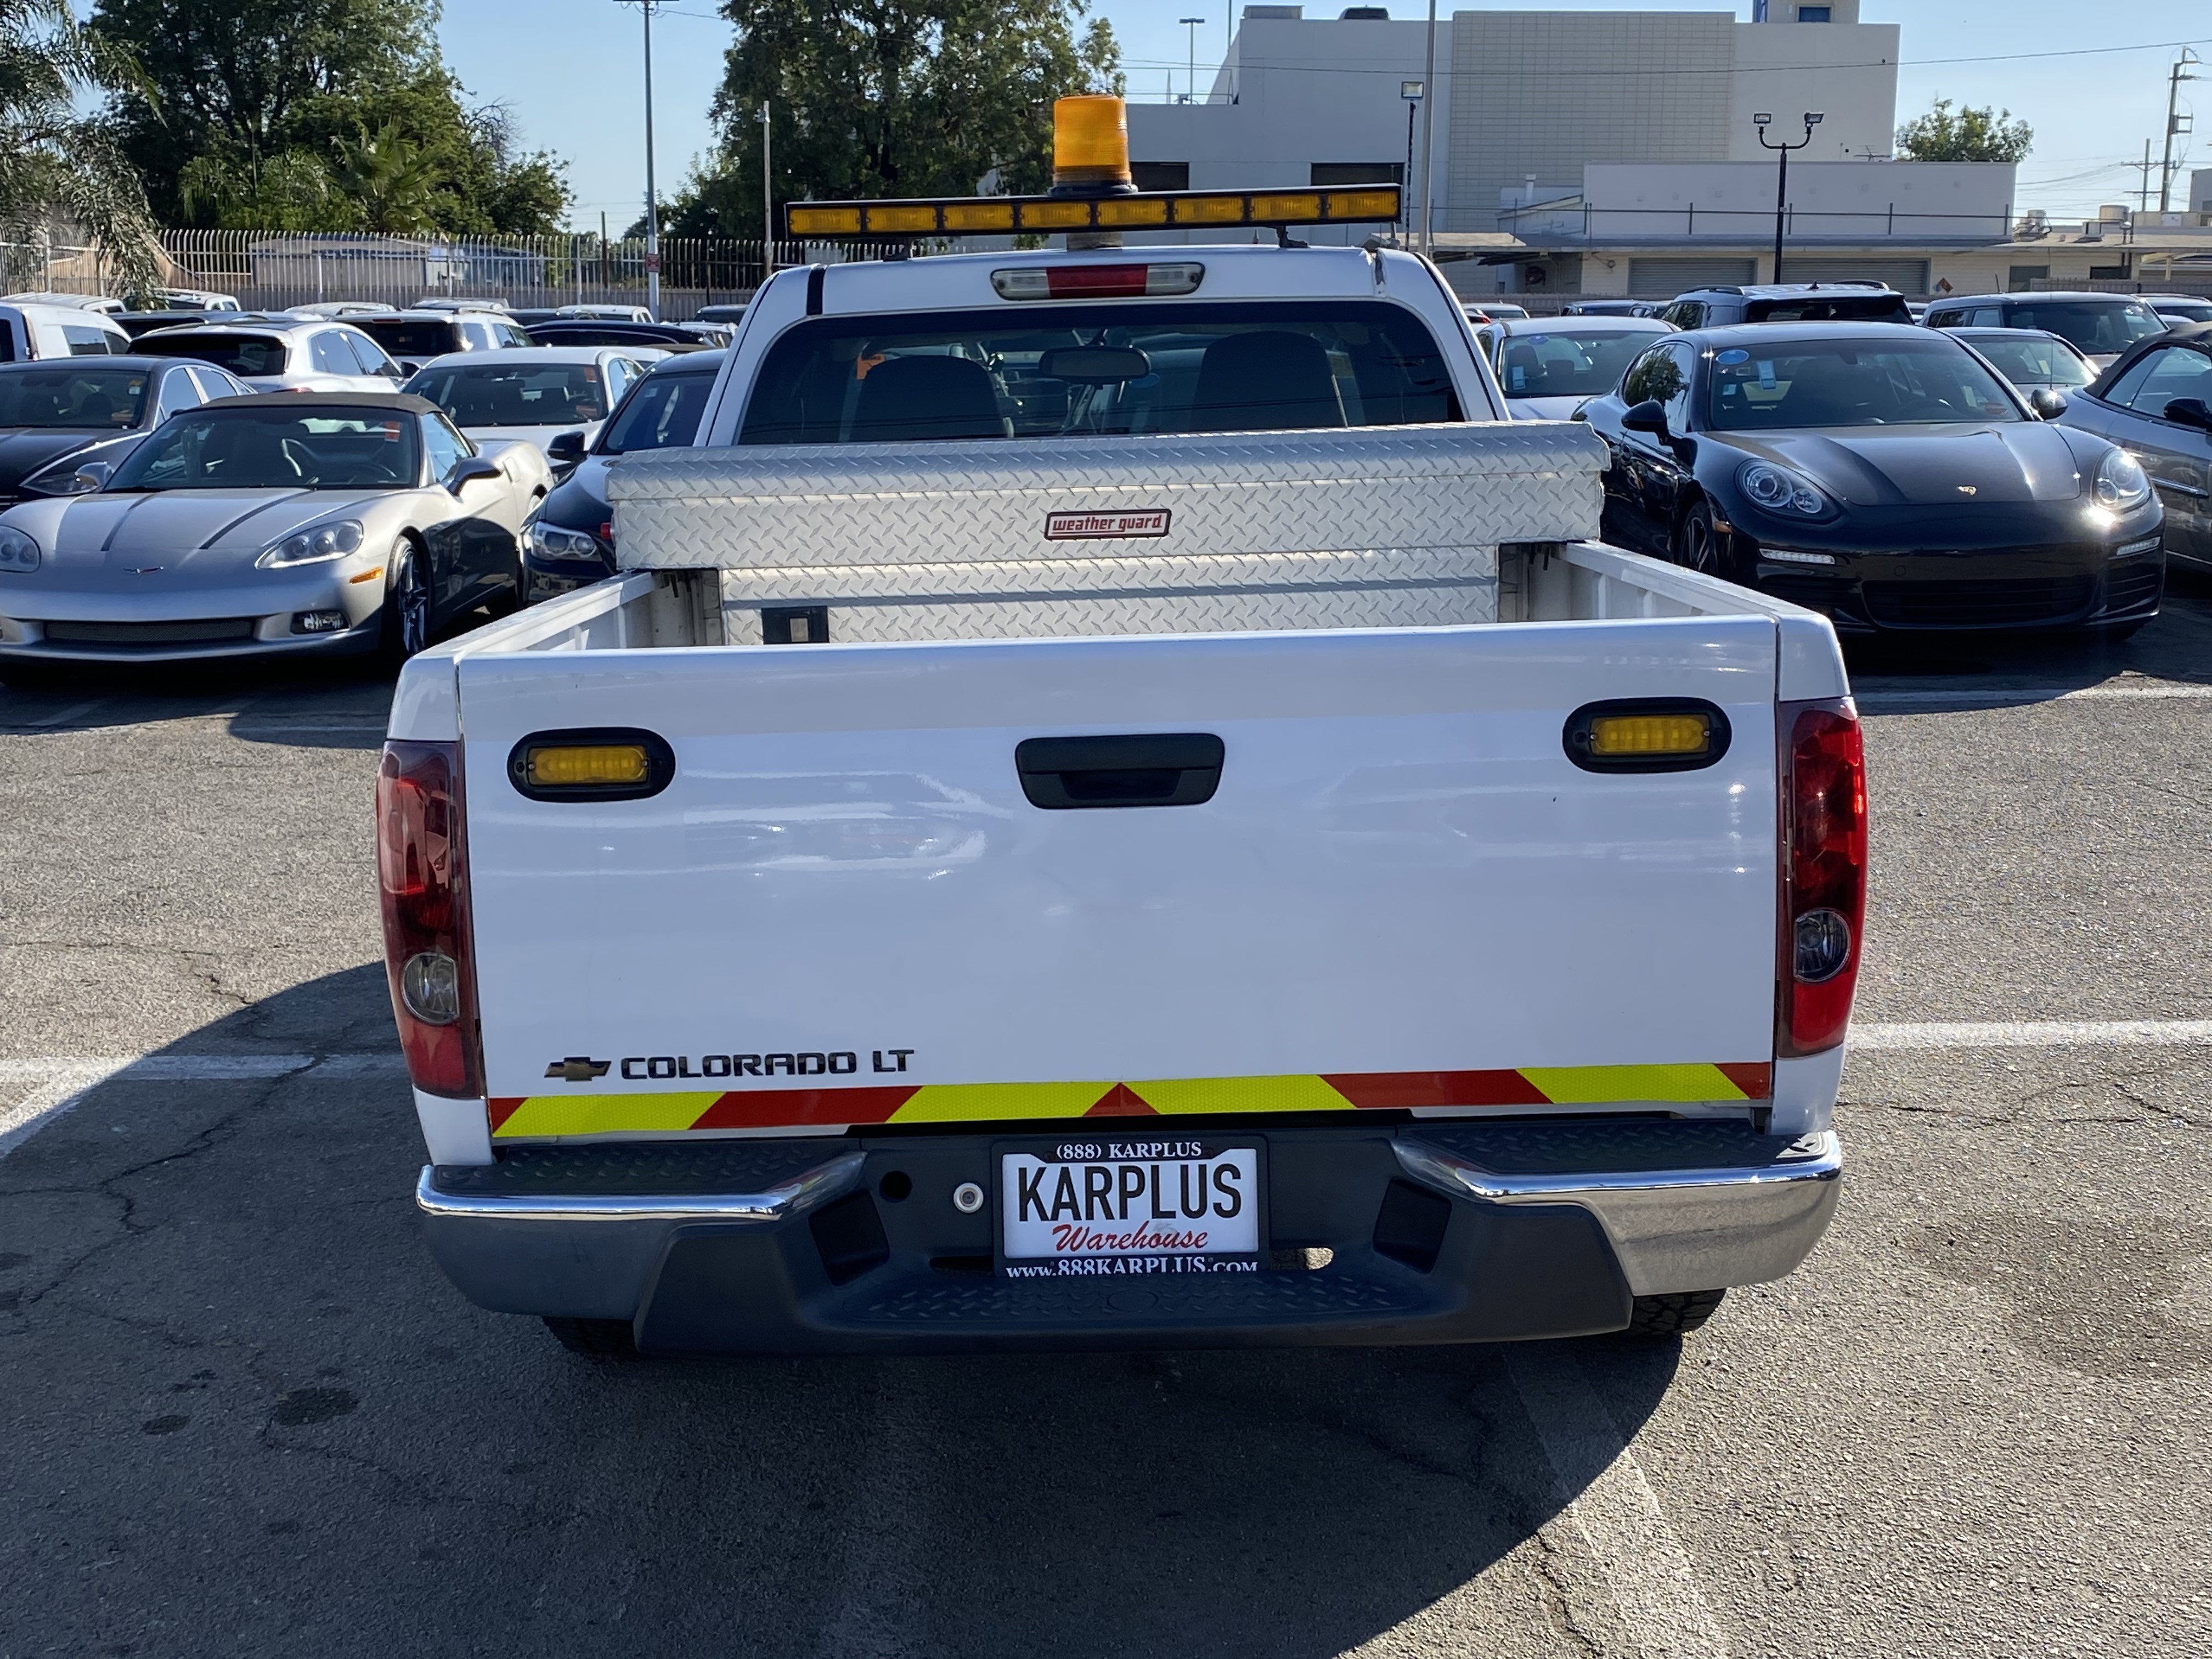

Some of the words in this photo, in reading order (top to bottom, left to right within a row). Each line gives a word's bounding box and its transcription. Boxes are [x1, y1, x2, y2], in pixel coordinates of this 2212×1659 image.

[1052, 517, 1115, 531] weather
[1118, 515, 1162, 530] guard
[621, 1051, 857, 1079] COLORADO
[873, 1049, 914, 1073] LT
[1056, 1144, 1102, 1159] (888)
[1108, 1142, 1201, 1158] KARPLUS
[1018, 1163, 1242, 1222] KARPLUS
[1052, 1220, 1209, 1252] Warehouse
